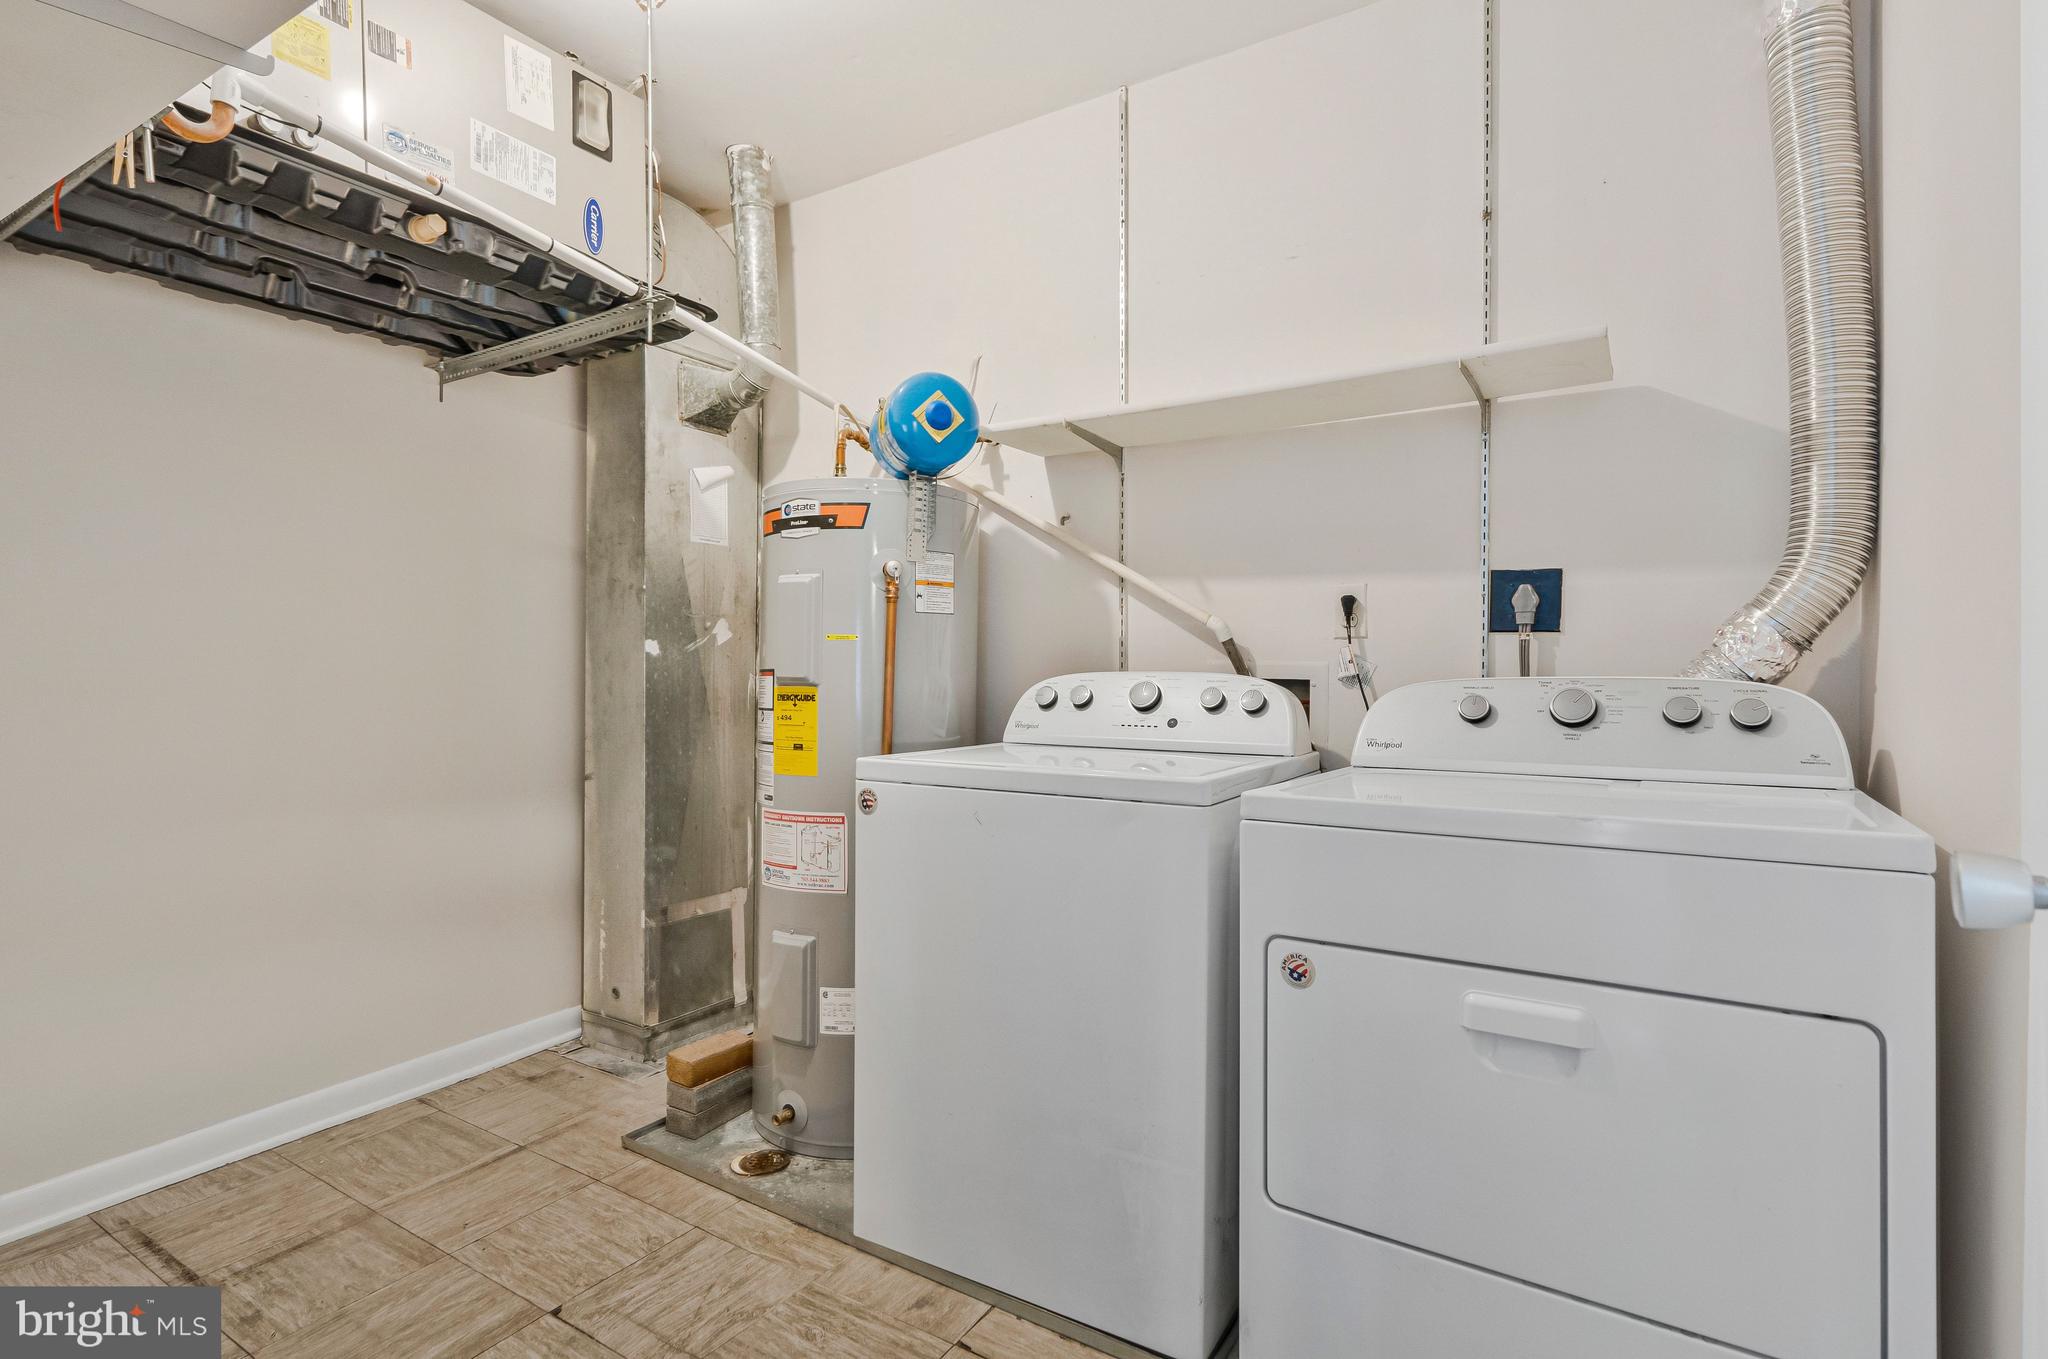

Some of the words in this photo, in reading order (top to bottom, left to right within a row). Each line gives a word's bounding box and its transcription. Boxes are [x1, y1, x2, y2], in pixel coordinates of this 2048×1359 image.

[408, 138, 438, 153] SERVICE
[590, 205, 599, 247] Carrier
[792, 503, 816, 512] state
[777, 693, 816, 702] ENERGYGUIDE
[1366, 740, 1403, 750] Whirlpool
[1281, 953, 1308, 971] AMERICA
